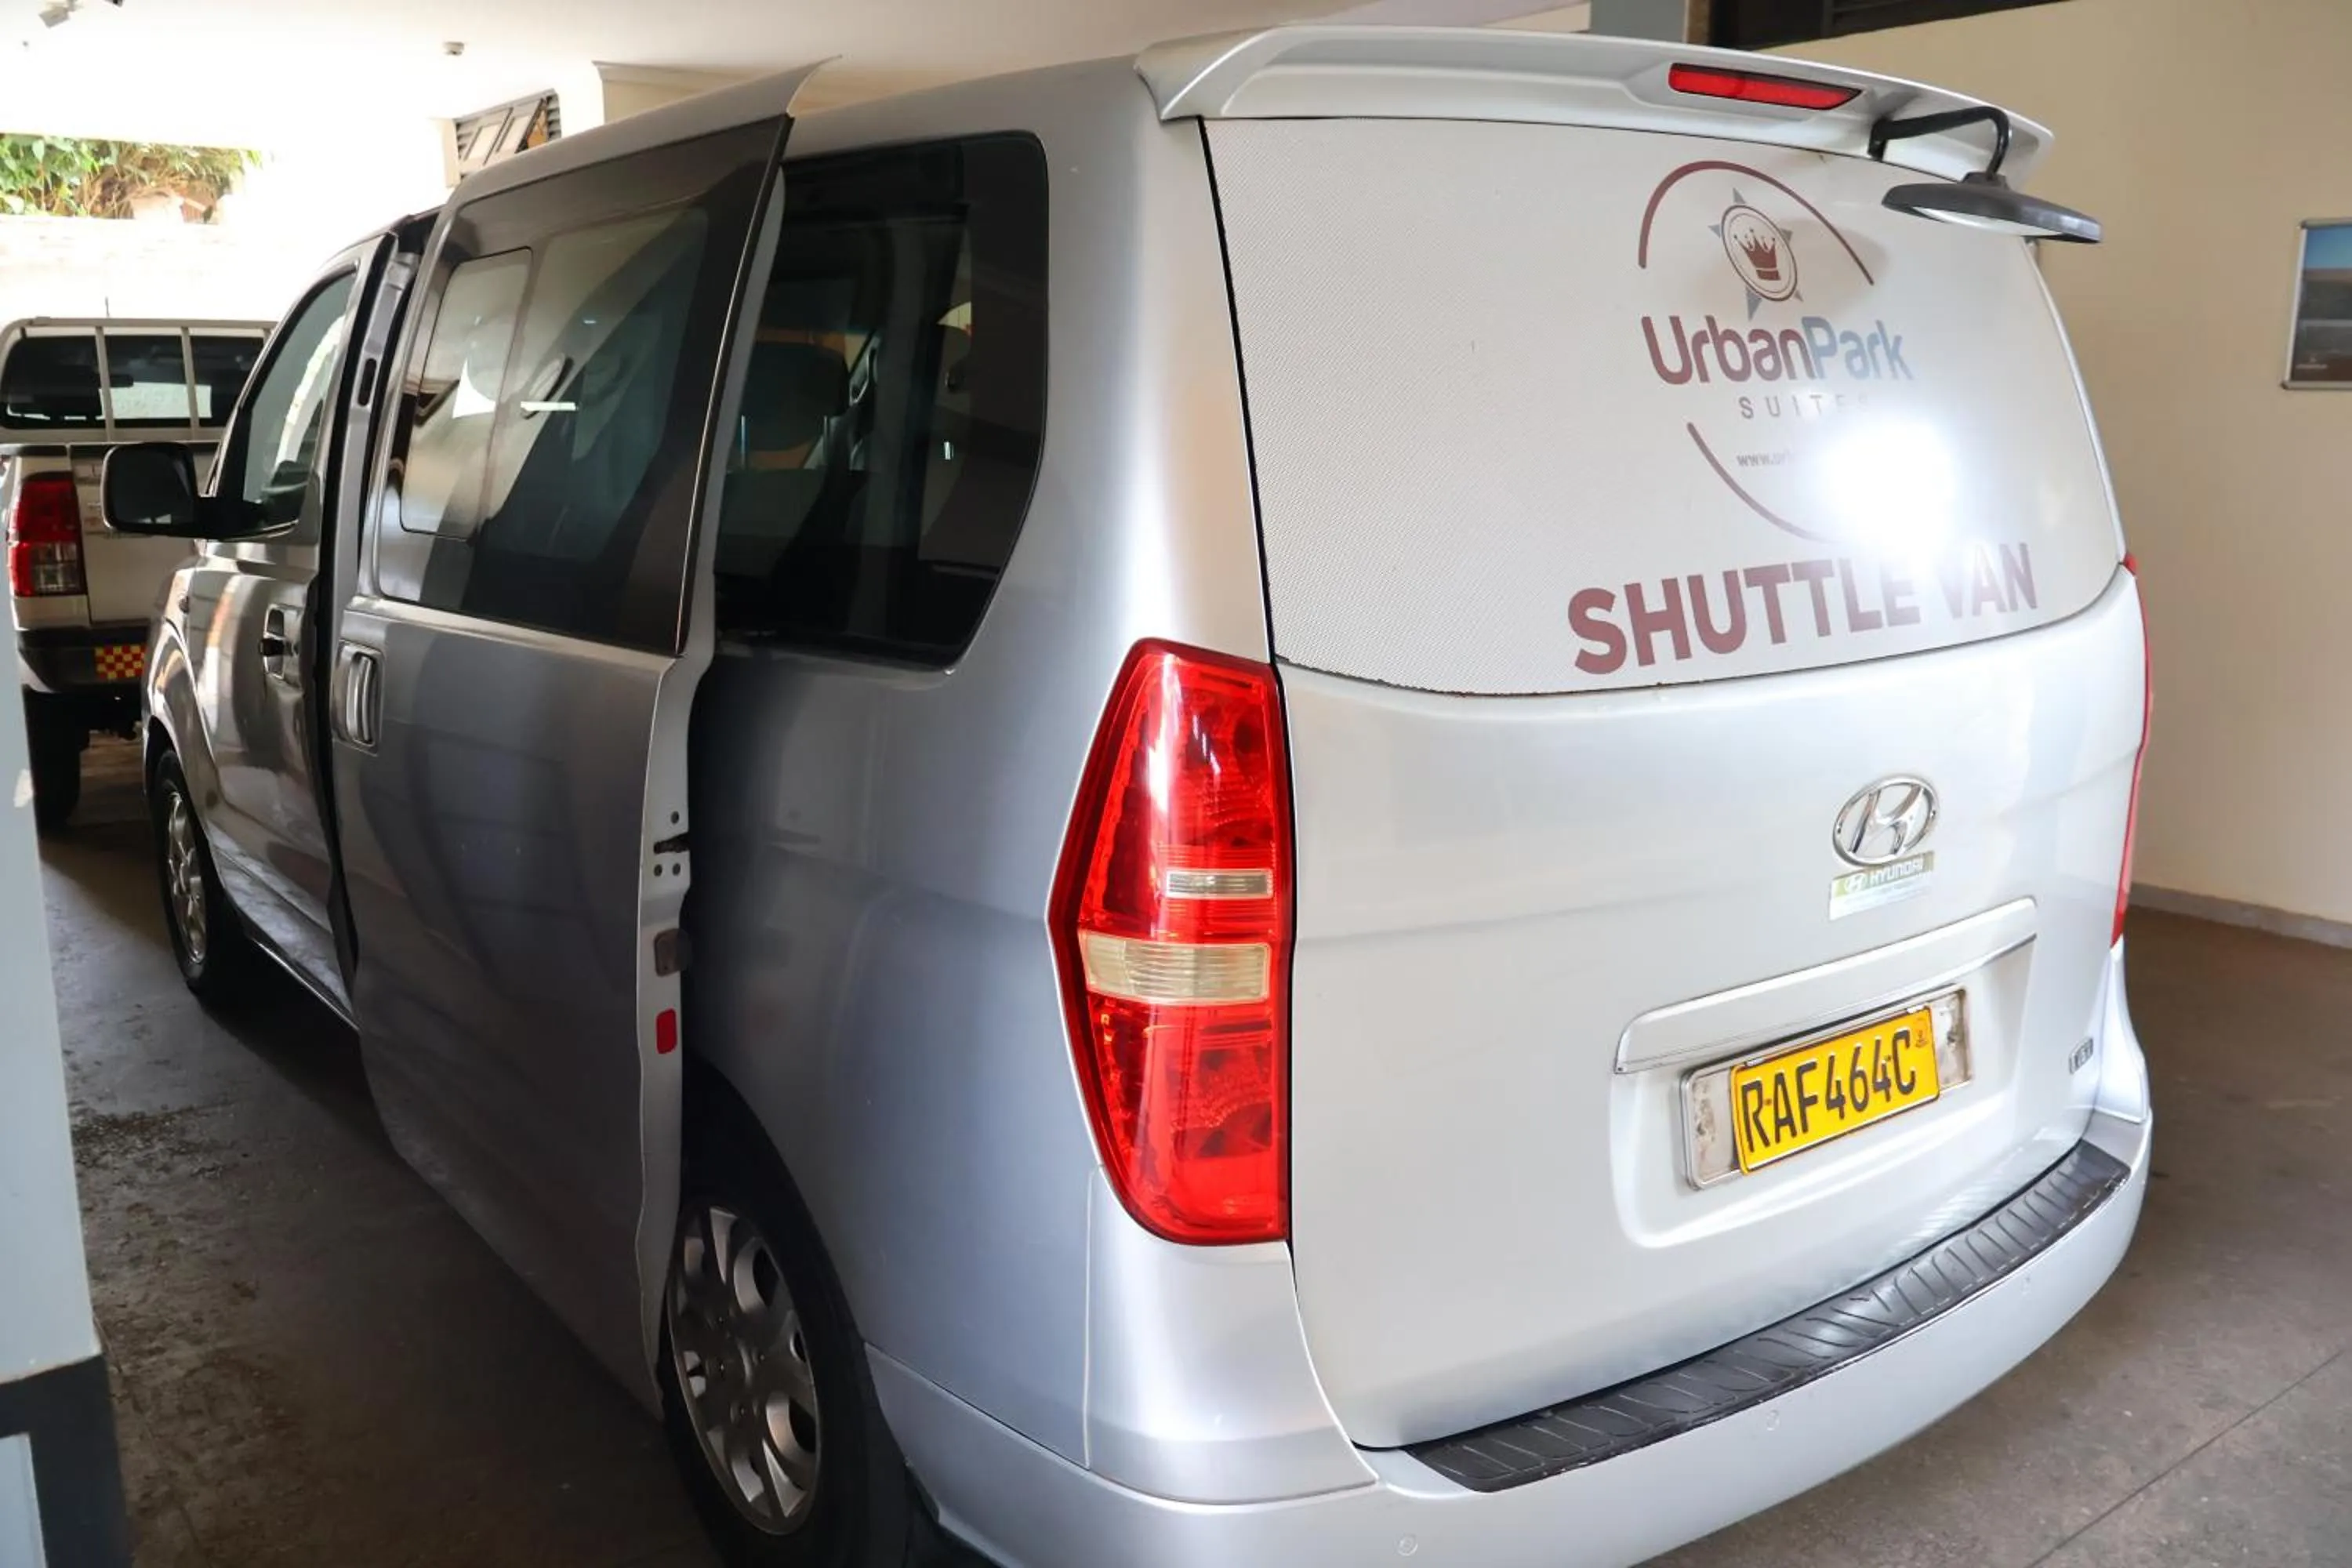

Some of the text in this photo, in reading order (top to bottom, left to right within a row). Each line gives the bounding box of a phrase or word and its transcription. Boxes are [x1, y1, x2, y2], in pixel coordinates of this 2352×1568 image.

[1642, 314, 1913, 385] UrbanPark
[1567, 542, 2038, 674] SHUTTLE VAN
[1740, 1028, 1916, 1153] RAF464C
